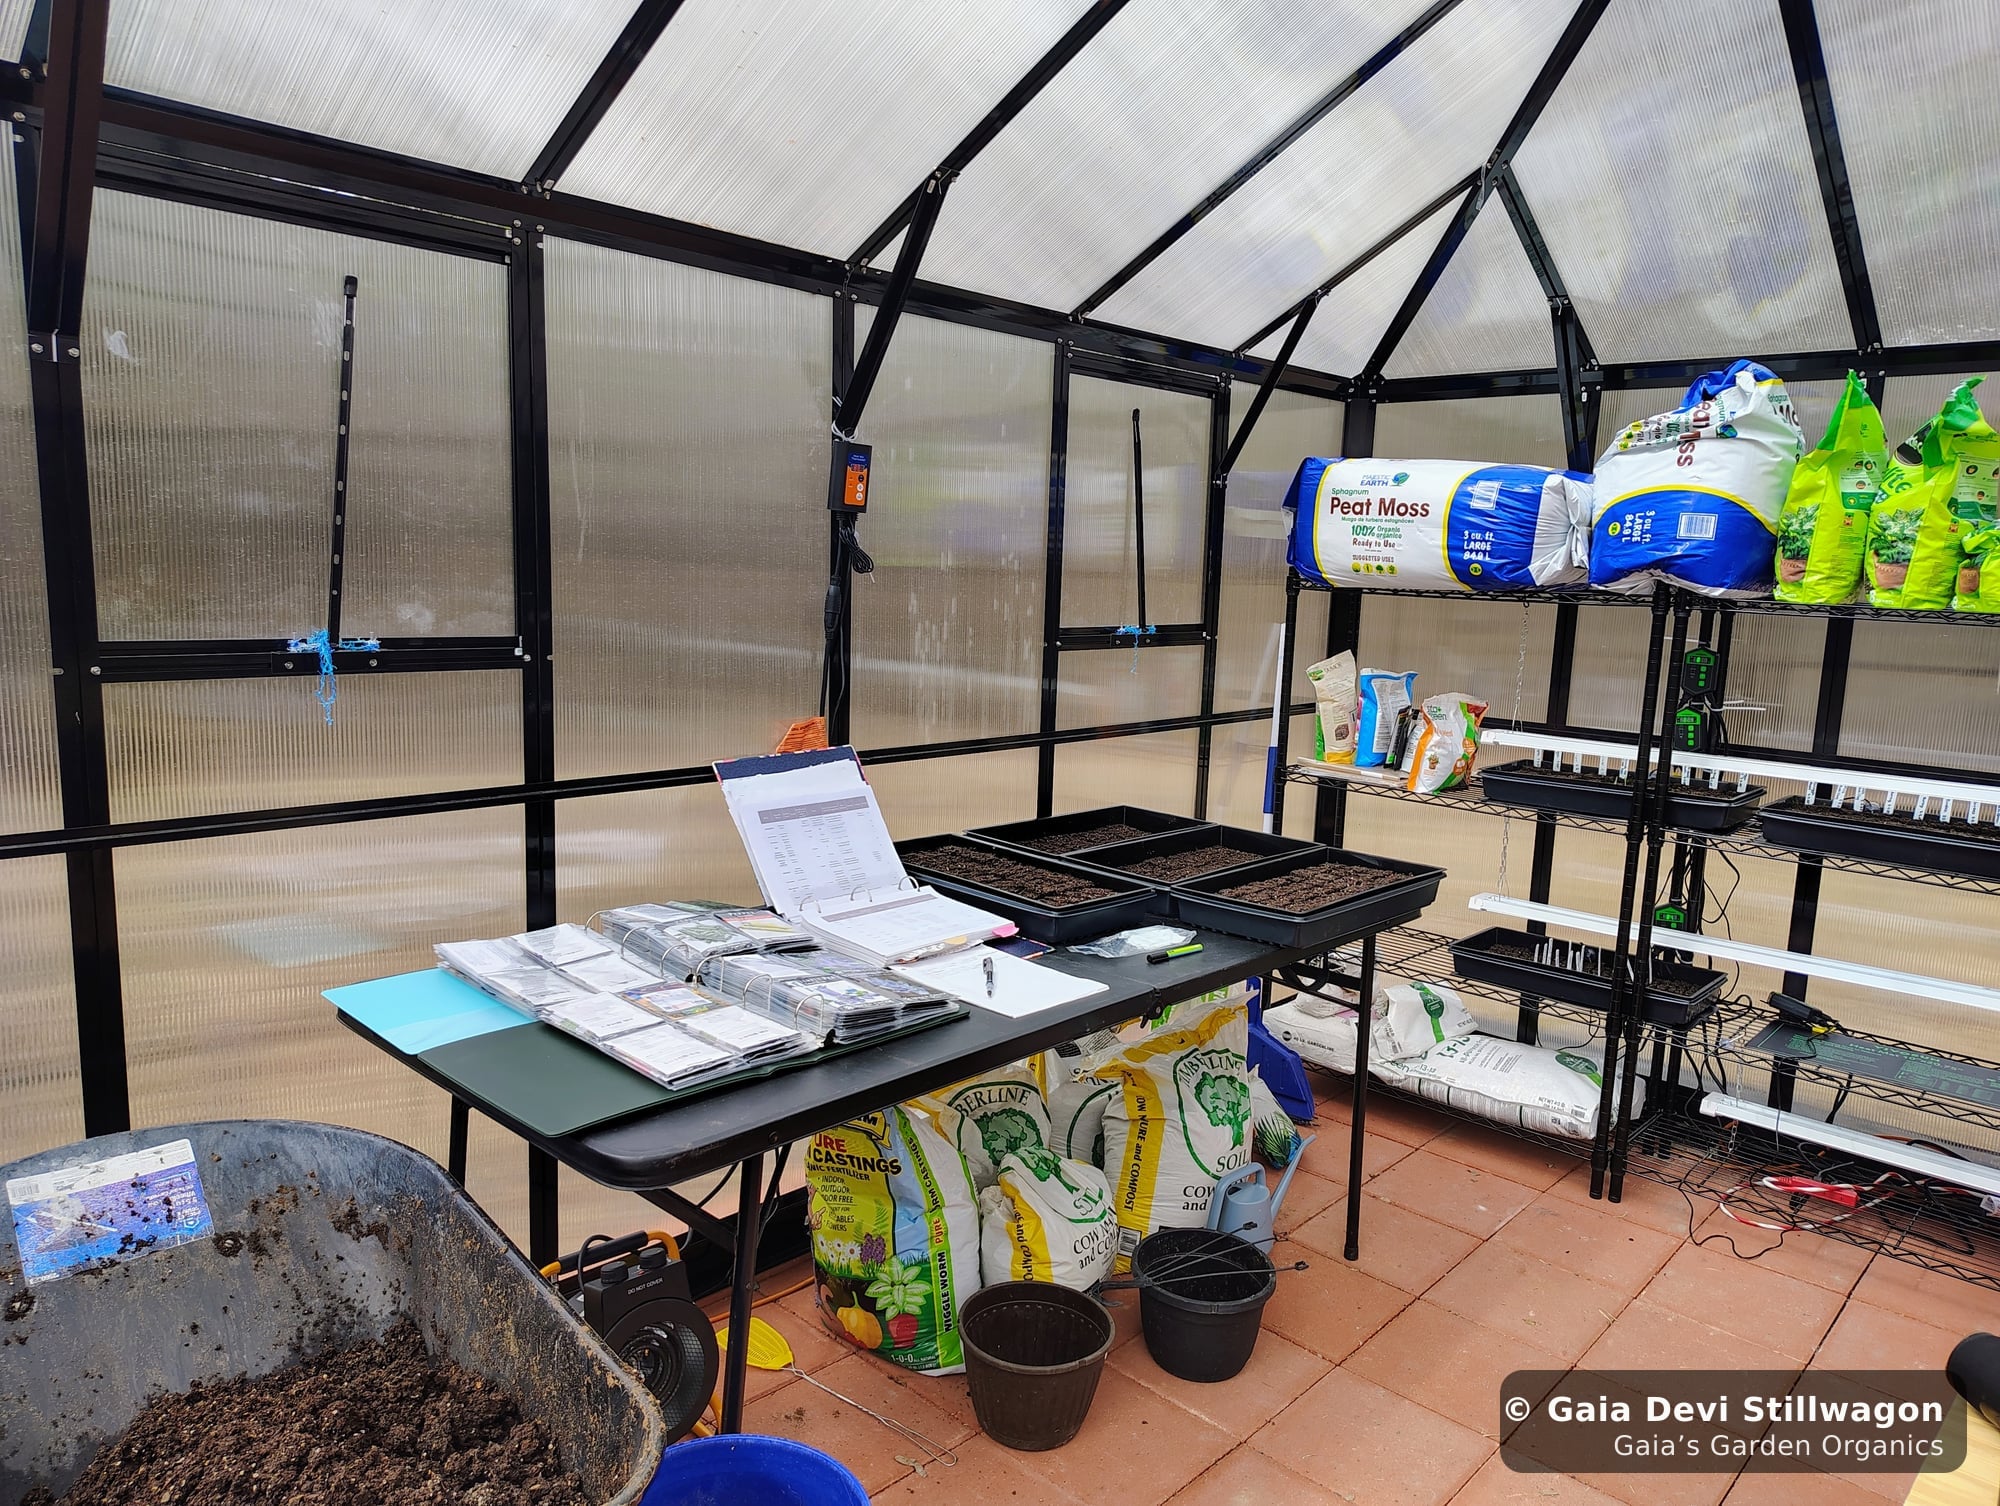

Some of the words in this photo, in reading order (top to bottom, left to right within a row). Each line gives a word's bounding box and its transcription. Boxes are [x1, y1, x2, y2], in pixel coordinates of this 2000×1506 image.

[1331, 487, 1370, 497] Sphagnum
[1330, 496, 1372, 516] Peat
[1378, 497, 1430, 517] Moss
[1351, 524, 1376, 536] 100%
[1463, 530, 1470, 540] 3
[1471, 532, 1483, 541] cu.
[1631, 512, 1645, 542] LARGE
[1352, 538, 1372, 548] Ready
[1375, 540, 1382, 548] to
[1383, 539, 1396, 548] Use
[1463, 540, 1492, 551] LARGE
[954, 1087, 1031, 1117] BERLINE
[814, 1133, 847, 1153] URE
[1133, 1142, 1143, 1161] and
[813, 1147, 902, 1177] CASTINGS
[1215, 1149, 1249, 1173] SOIL
[826, 1165, 871, 1181] FERTILIZER
[1124, 1162, 1141, 1212] COMPOST
[838, 1195, 853, 1203] FREE
[1182, 1199, 1208, 1211] and
[932, 1217, 944, 1244] PURE
[1015, 1223, 1027, 1243] and
[1073, 1227, 1099, 1255] COW
[1020, 1245, 1034, 1281] COMPO
[1079, 1247, 1097, 1269] and
[937, 1251, 948, 1290] WORM
[627, 1287, 636, 1295] DO
[646, 1277, 664, 1288] COVER
[891, 1353, 914, 1363] 1-0-0
